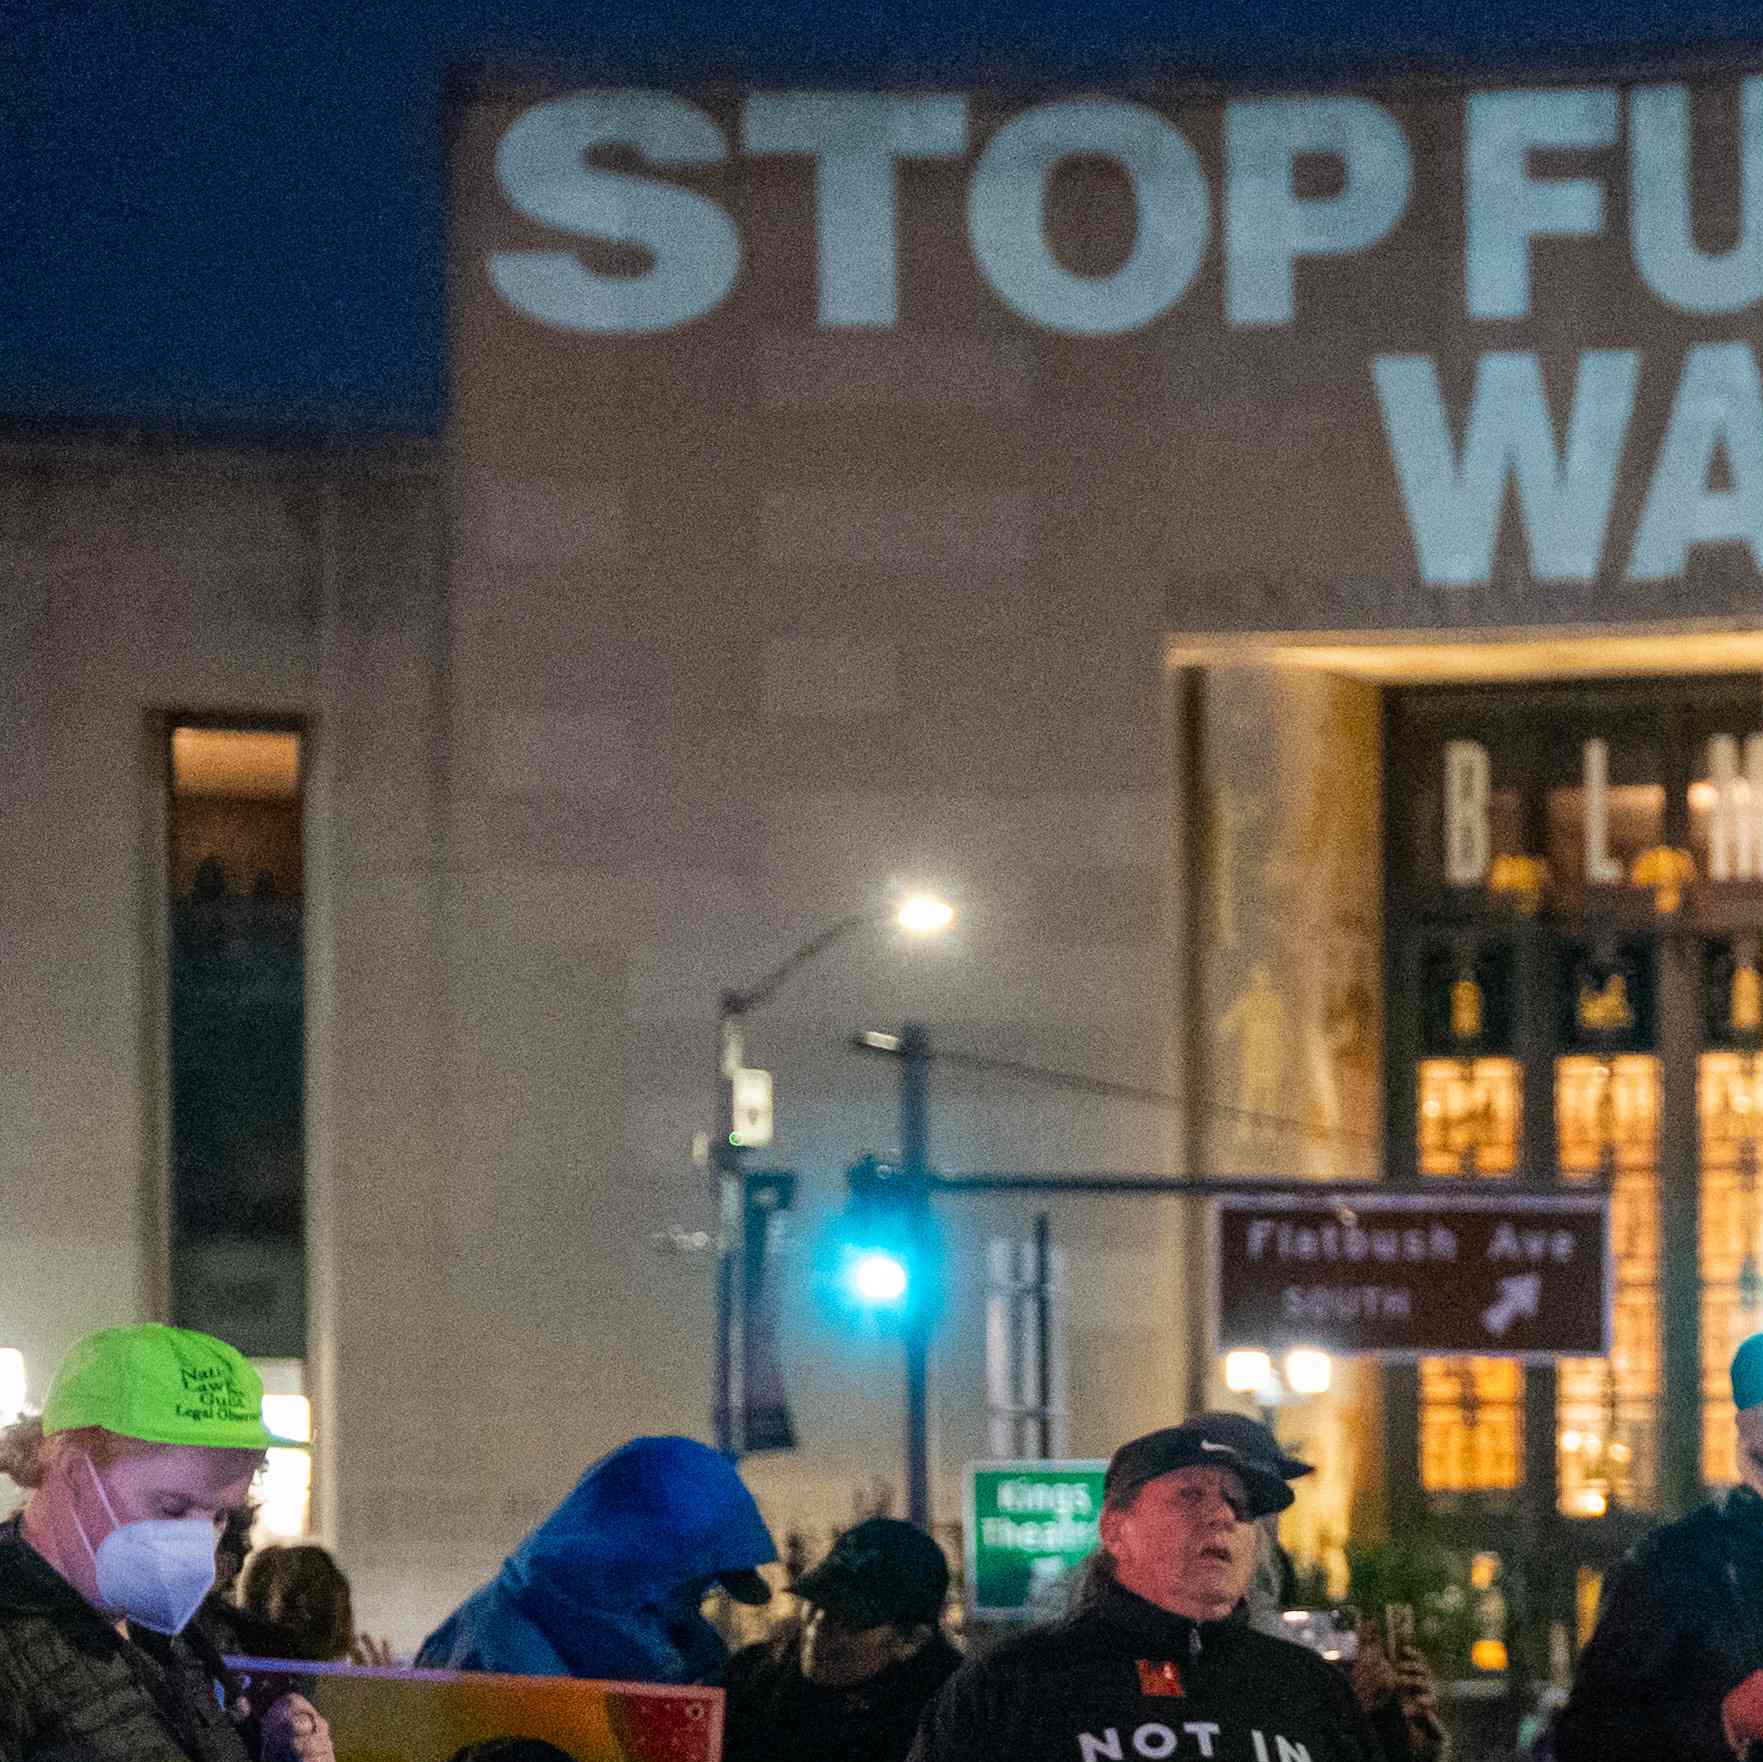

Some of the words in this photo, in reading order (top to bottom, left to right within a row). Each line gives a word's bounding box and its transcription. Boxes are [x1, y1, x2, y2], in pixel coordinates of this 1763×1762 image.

[486, 86, 1412, 335] STOP
[1248, 1220, 1457, 1263] Flatbush
[1488, 1222, 1576, 1263] Ave
[997, 1477, 1092, 1518] Kings
